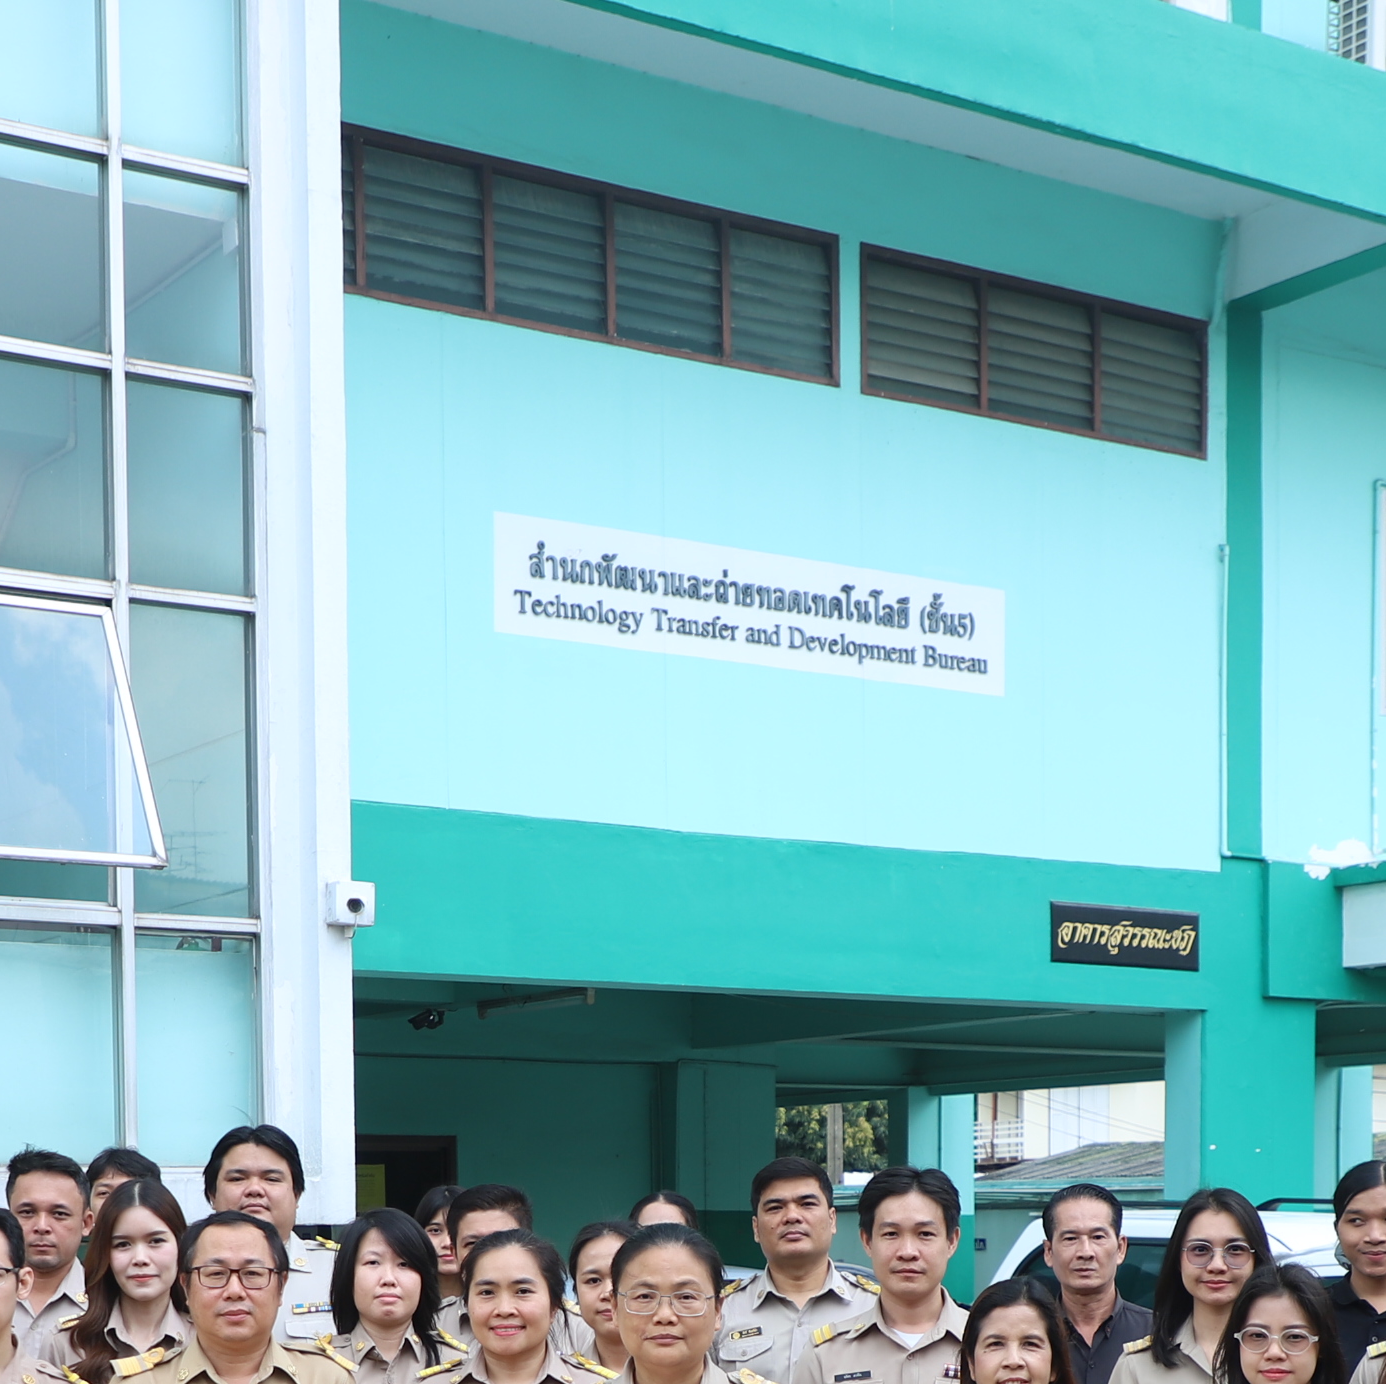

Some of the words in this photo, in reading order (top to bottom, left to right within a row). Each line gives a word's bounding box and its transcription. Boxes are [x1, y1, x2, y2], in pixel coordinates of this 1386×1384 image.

[514, 589, 643, 634] Technology
[651, 607, 739, 642] Transfer
[745, 624, 781, 647] and
[788, 626, 916, 665] Development
[923, 645, 988, 674] Bureau
